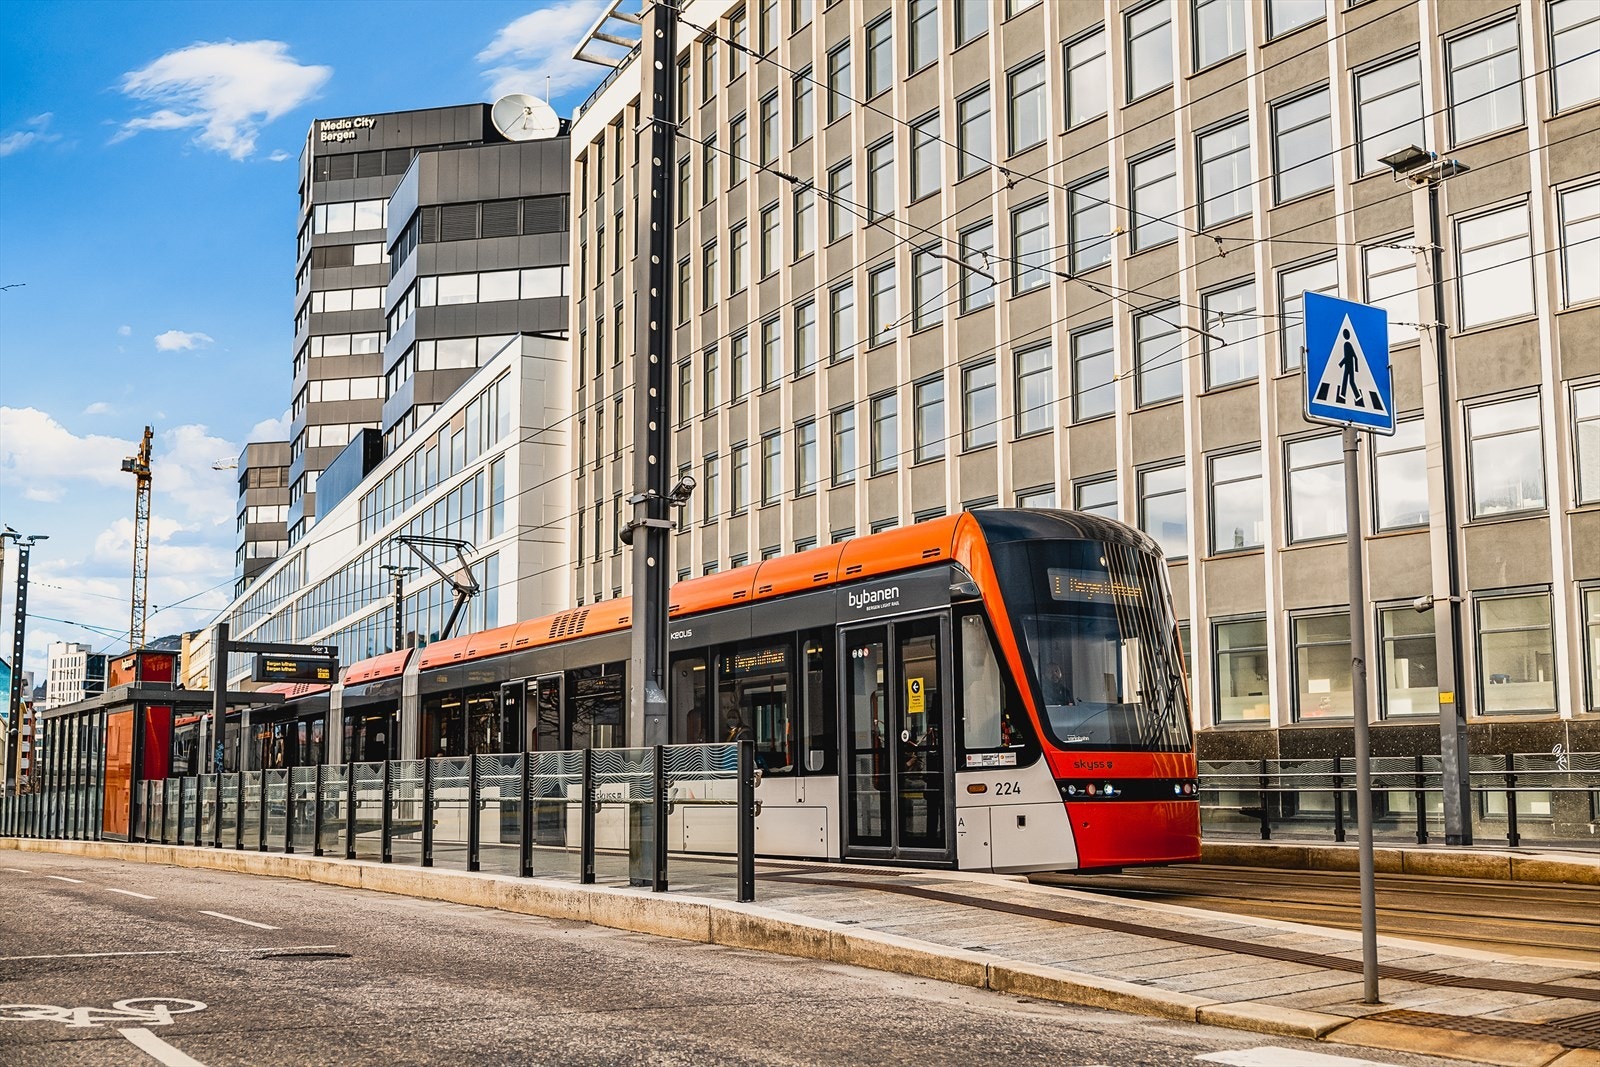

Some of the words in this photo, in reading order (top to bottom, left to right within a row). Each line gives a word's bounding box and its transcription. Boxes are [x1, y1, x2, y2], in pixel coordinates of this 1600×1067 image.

[320, 120, 352, 131] Media
[353, 117, 376, 129] City
[320, 131, 356, 142] Bergen
[848, 586, 900, 609] bybanen
[323, 646, 330, 654] 1
[1073, 759, 1105, 771] skyss
[995, 781, 1022, 796] 224
[957, 817, 965, 827] A
